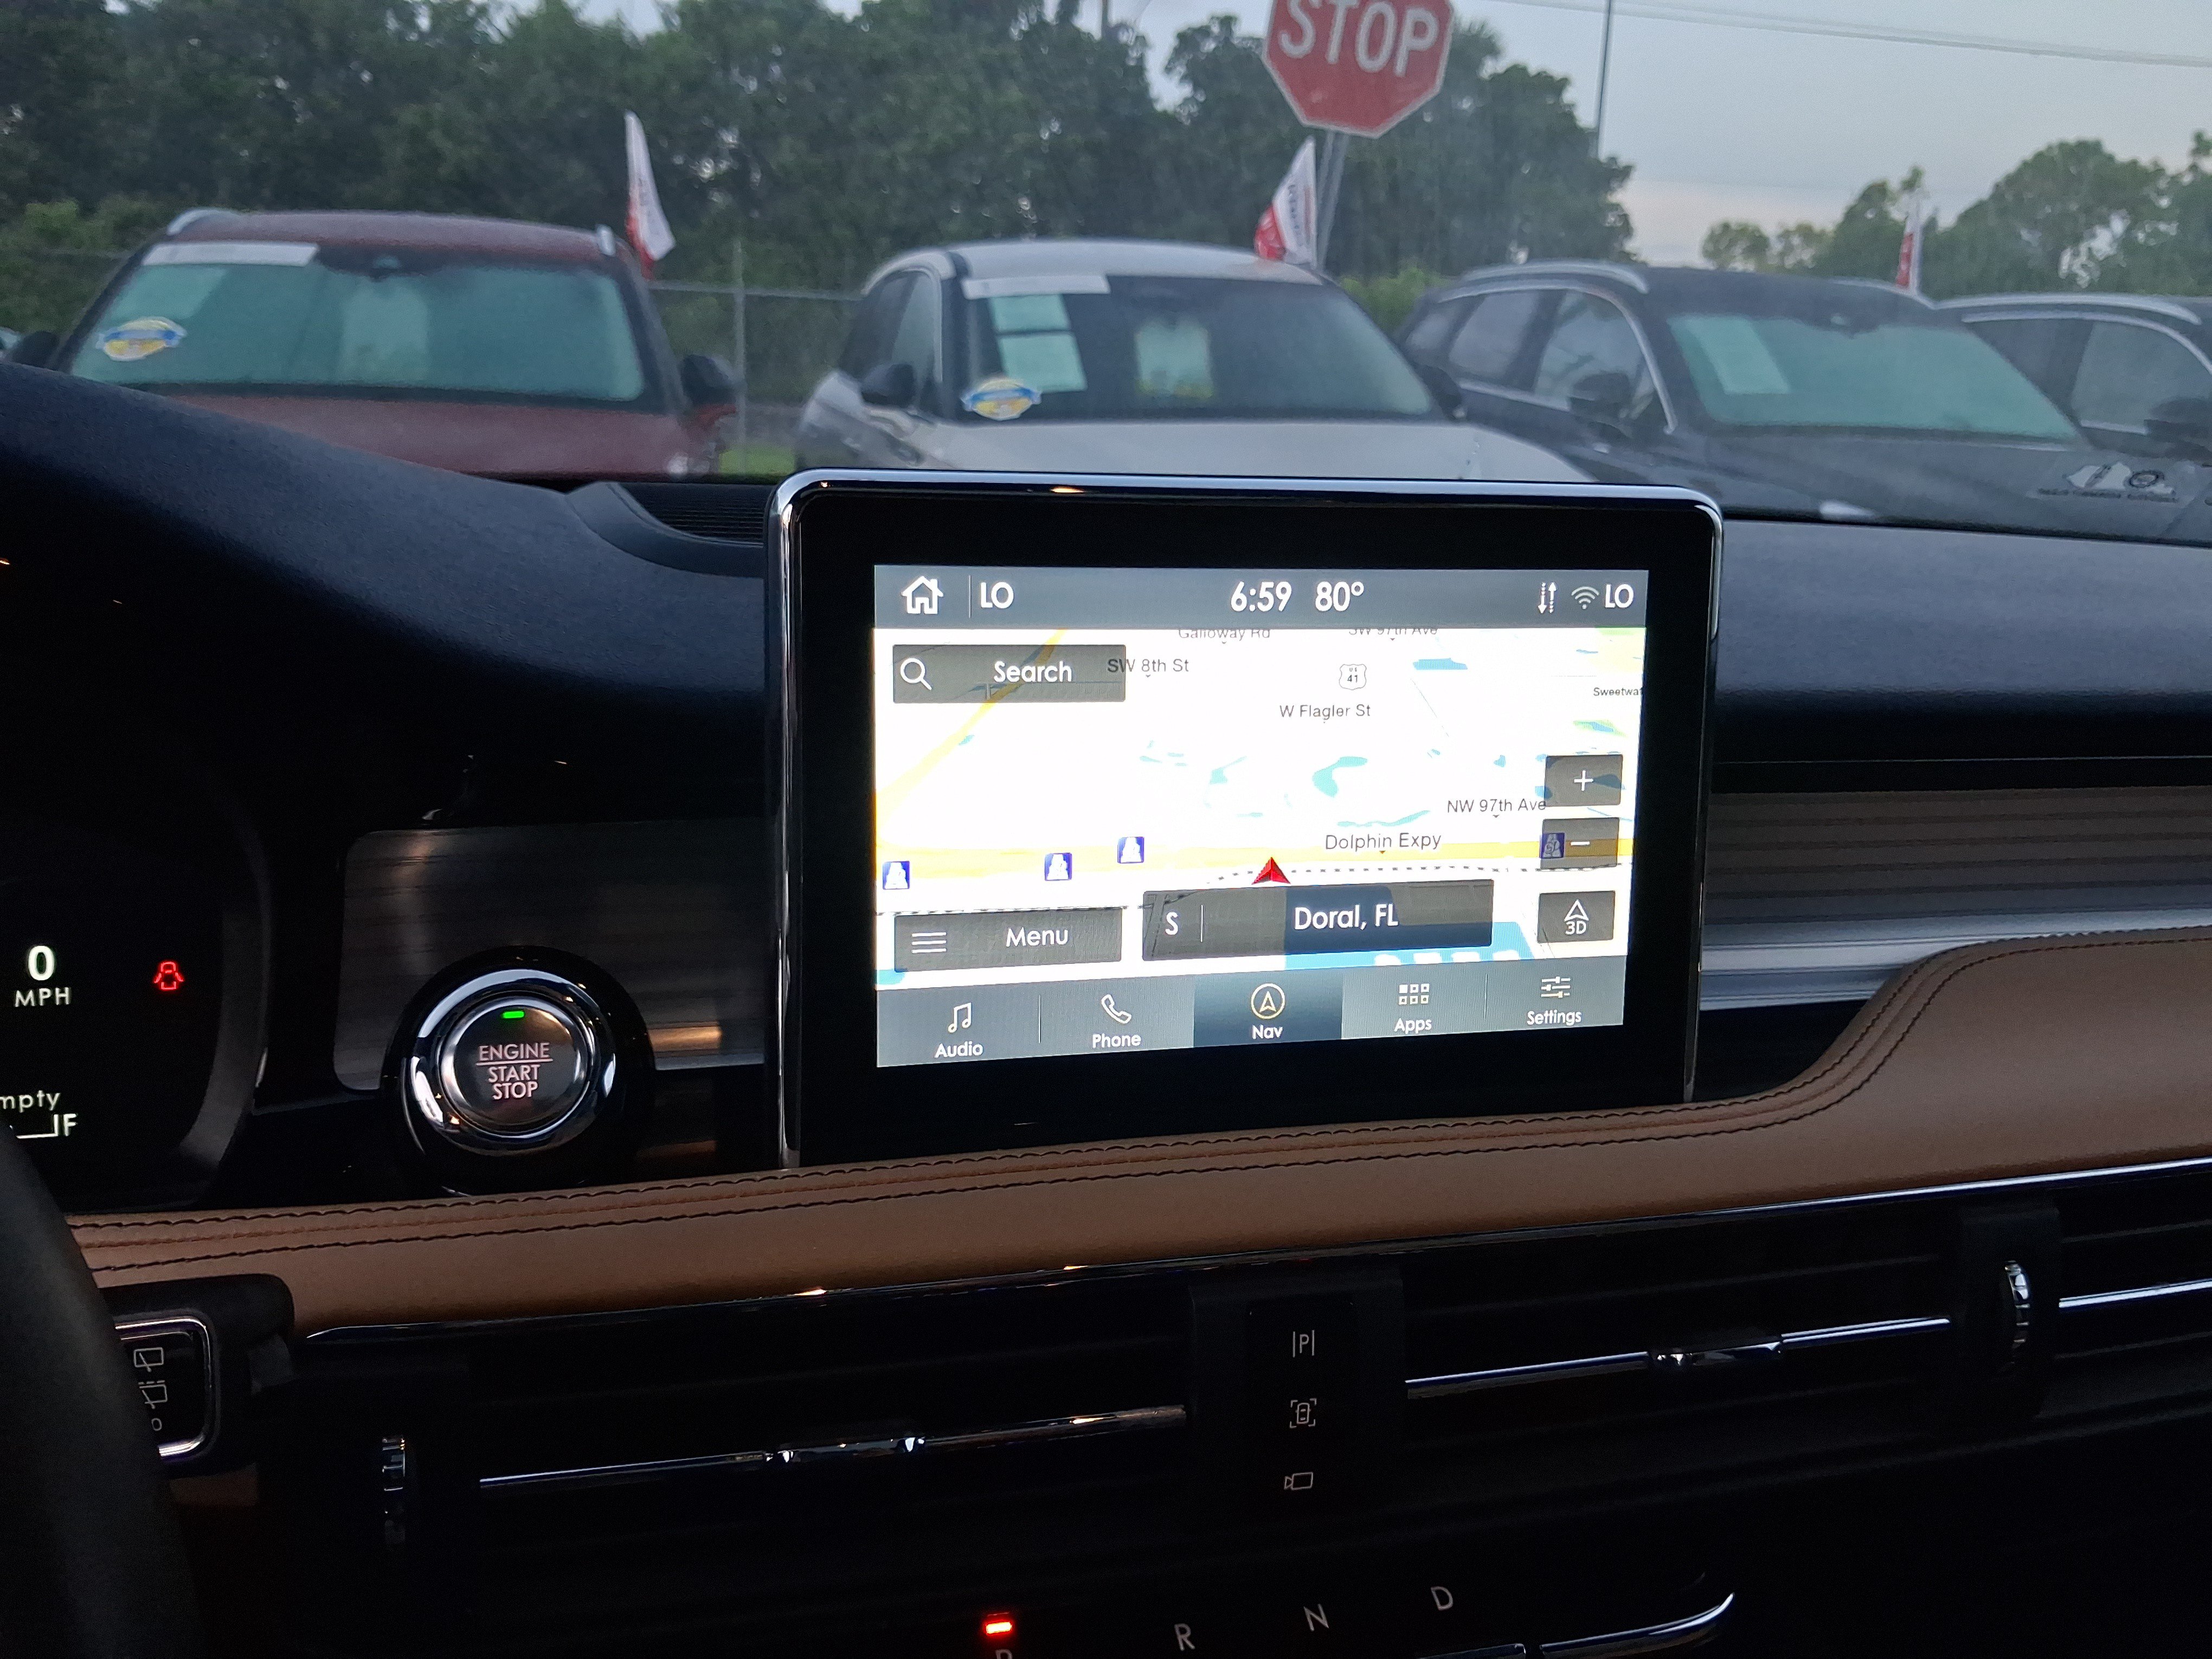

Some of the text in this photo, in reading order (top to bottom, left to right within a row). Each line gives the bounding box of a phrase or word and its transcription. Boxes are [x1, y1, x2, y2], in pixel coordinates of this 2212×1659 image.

[1279, 0, 1439, 76] STOP
[980, 581, 1014, 609] LO
[1231, 581, 1292, 612] 6:59
[1604, 583, 1634, 608] LO
[1179, 629, 1245, 641] Galloway
[994, 660, 1072, 683] Search
[1107, 658, 1189, 673] SW 8th St
[1346, 674, 1358, 683] 41
[1279, 704, 1371, 720] W Flagler St
[1448, 798, 1546, 813] NW 97th Ave
[1326, 832, 1442, 852] Dolphin Expy
[1165, 911, 1179, 936] S
[1294, 903, 1399, 931] Doral, FL
[1005, 927, 1069, 947] Menu
[1565, 921, 1587, 935] 3D
[28, 945, 55, 981] 0
[14, 987, 71, 1007] MPH
[1393, 1017, 1432, 1034] Apps
[1526, 1009, 1582, 1026] Settings
[1092, 1033, 1142, 1049] Phone
[1251, 1024, 1283, 1040] Nav
[479, 1042, 550, 1061] ENGINE
[934, 1042, 983, 1059] Audio
[488, 1064, 541, 1083] START
[492, 1082, 538, 1100] STOP
[1431, 1586, 1454, 1611] D
[1303, 1603, 1329, 1632] N
[1174, 1623, 1195, 1651] R
